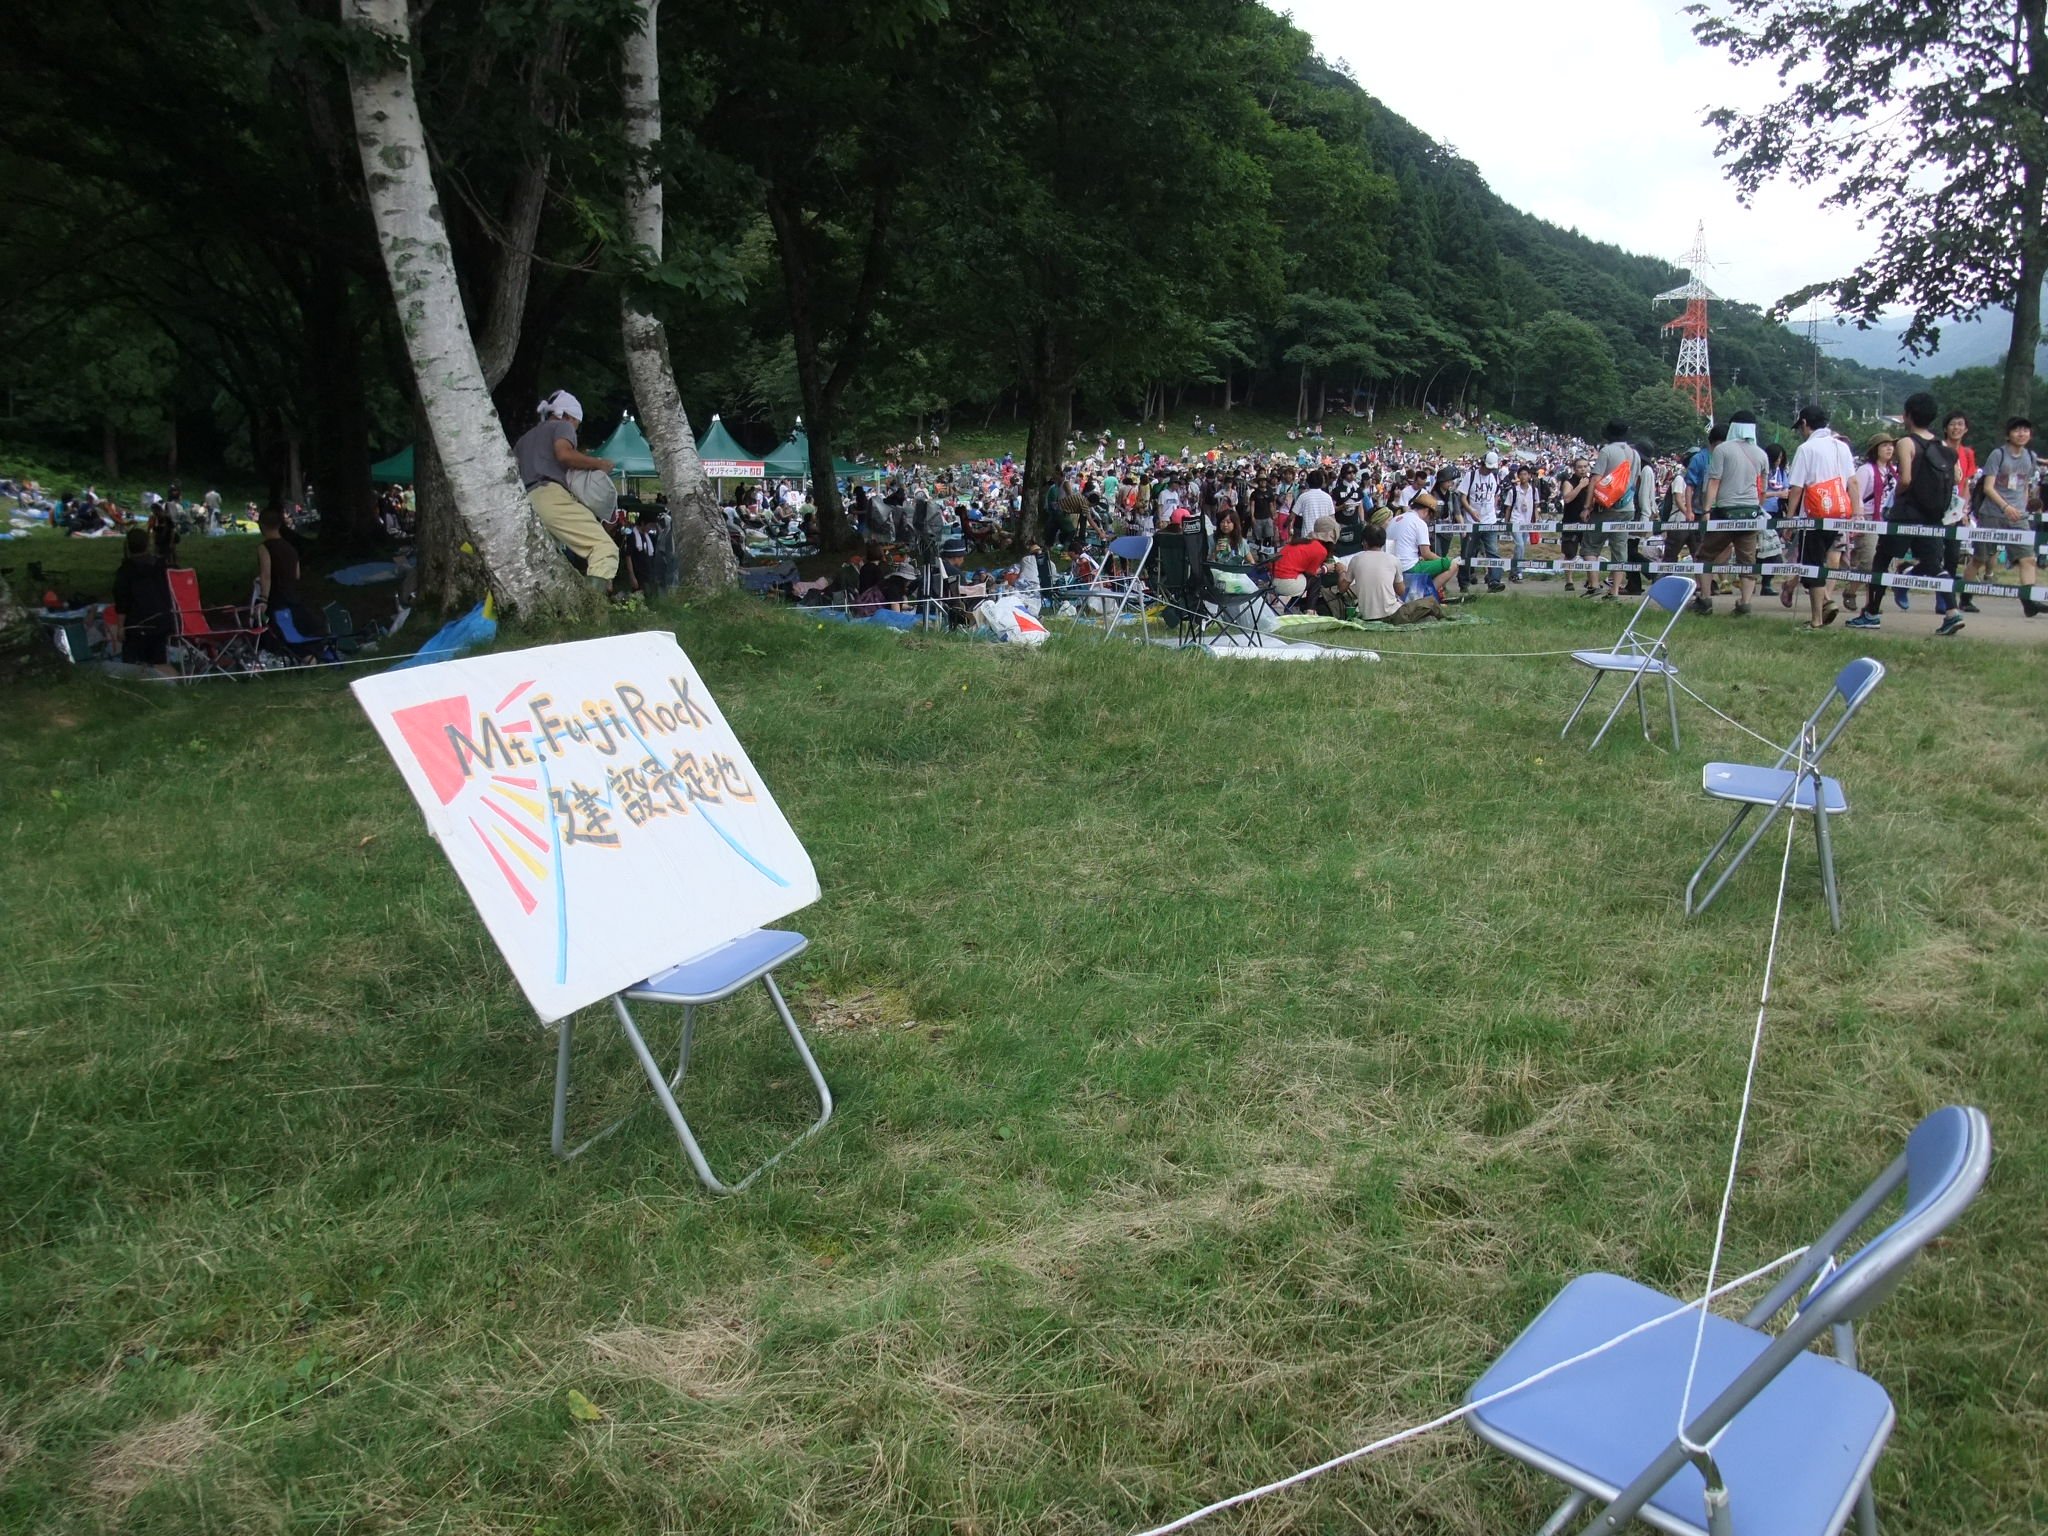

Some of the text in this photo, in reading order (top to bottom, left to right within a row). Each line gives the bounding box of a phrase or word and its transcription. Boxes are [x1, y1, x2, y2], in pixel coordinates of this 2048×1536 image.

[444, 711, 547, 780] Mt.
[528, 693, 629, 757] Fuji
[548, 747, 756, 848] 建設予定地
